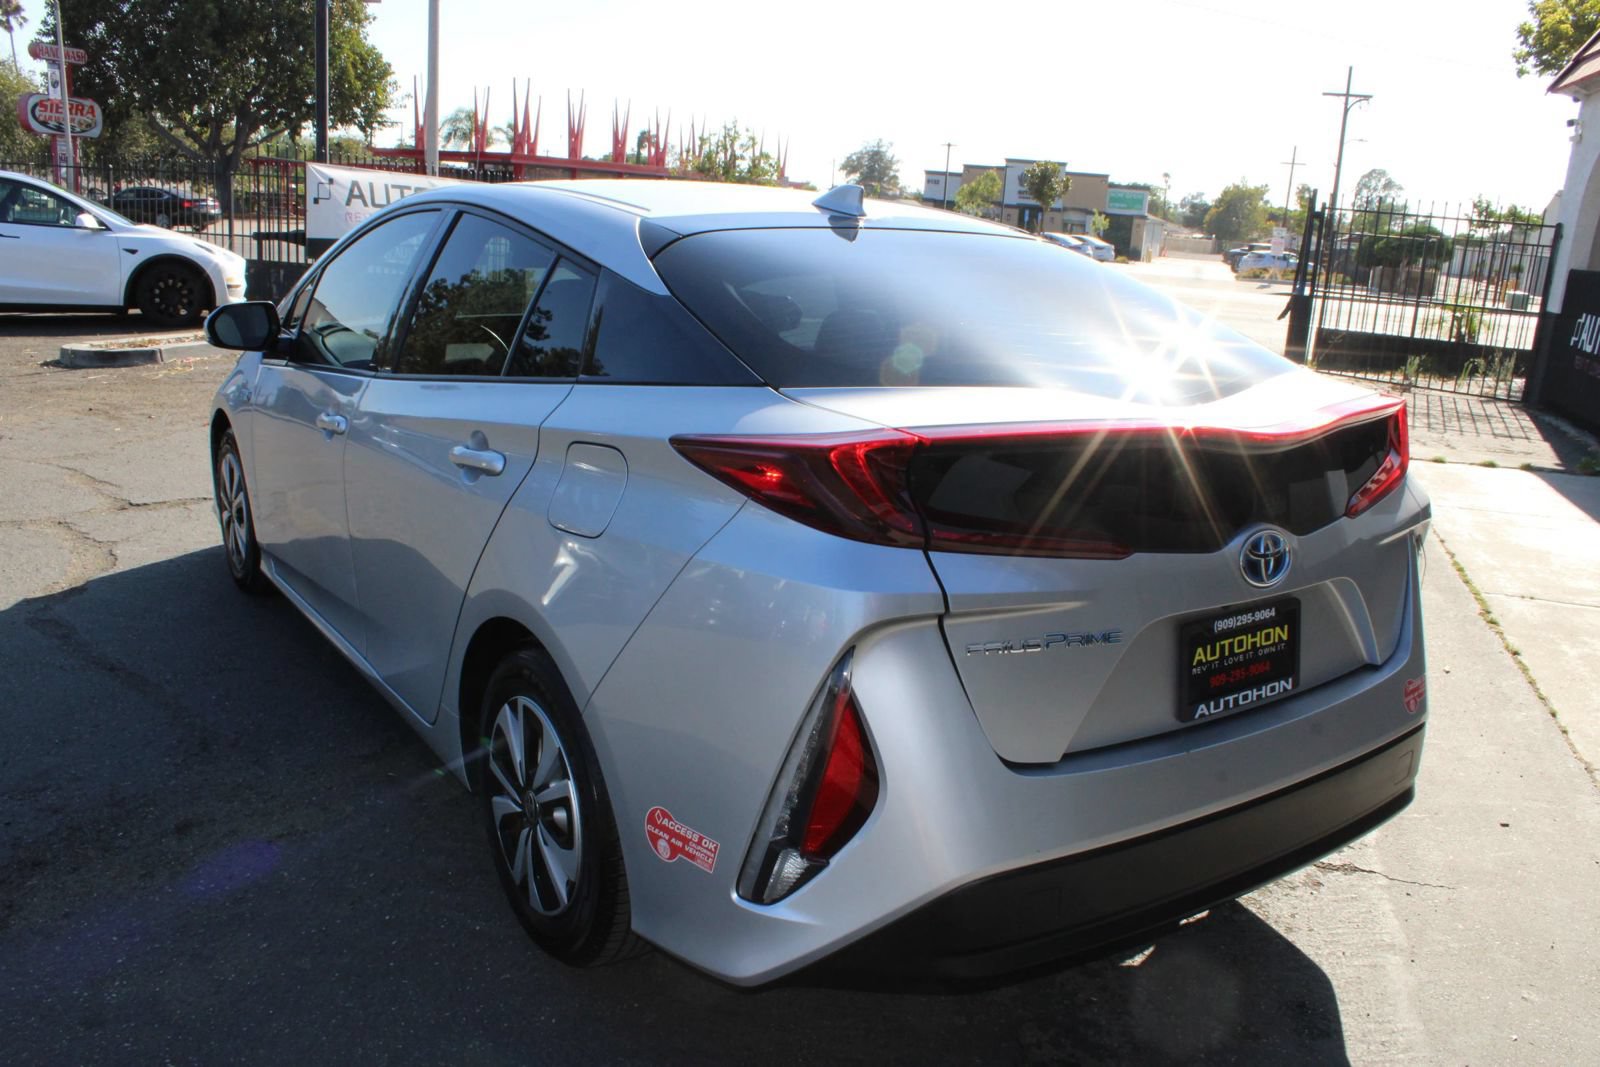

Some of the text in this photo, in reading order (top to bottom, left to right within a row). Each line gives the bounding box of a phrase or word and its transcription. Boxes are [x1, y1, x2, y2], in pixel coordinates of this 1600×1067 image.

[38, 99, 97, 118] SIERRA
[1213, 607, 1276, 633] (909)295-9064
[1043, 630, 1123, 650] PRIME
[1192, 624, 1288, 666] AUTOHON
[1224, 654, 1244, 666] LOVE
[1258, 645, 1276, 656] OWN
[1194, 677, 1293, 719] AUTOHON
[647, 824, 713, 863] CLEAN AIR VEHICLE
[661, 818, 717, 852] ACCESS OK
